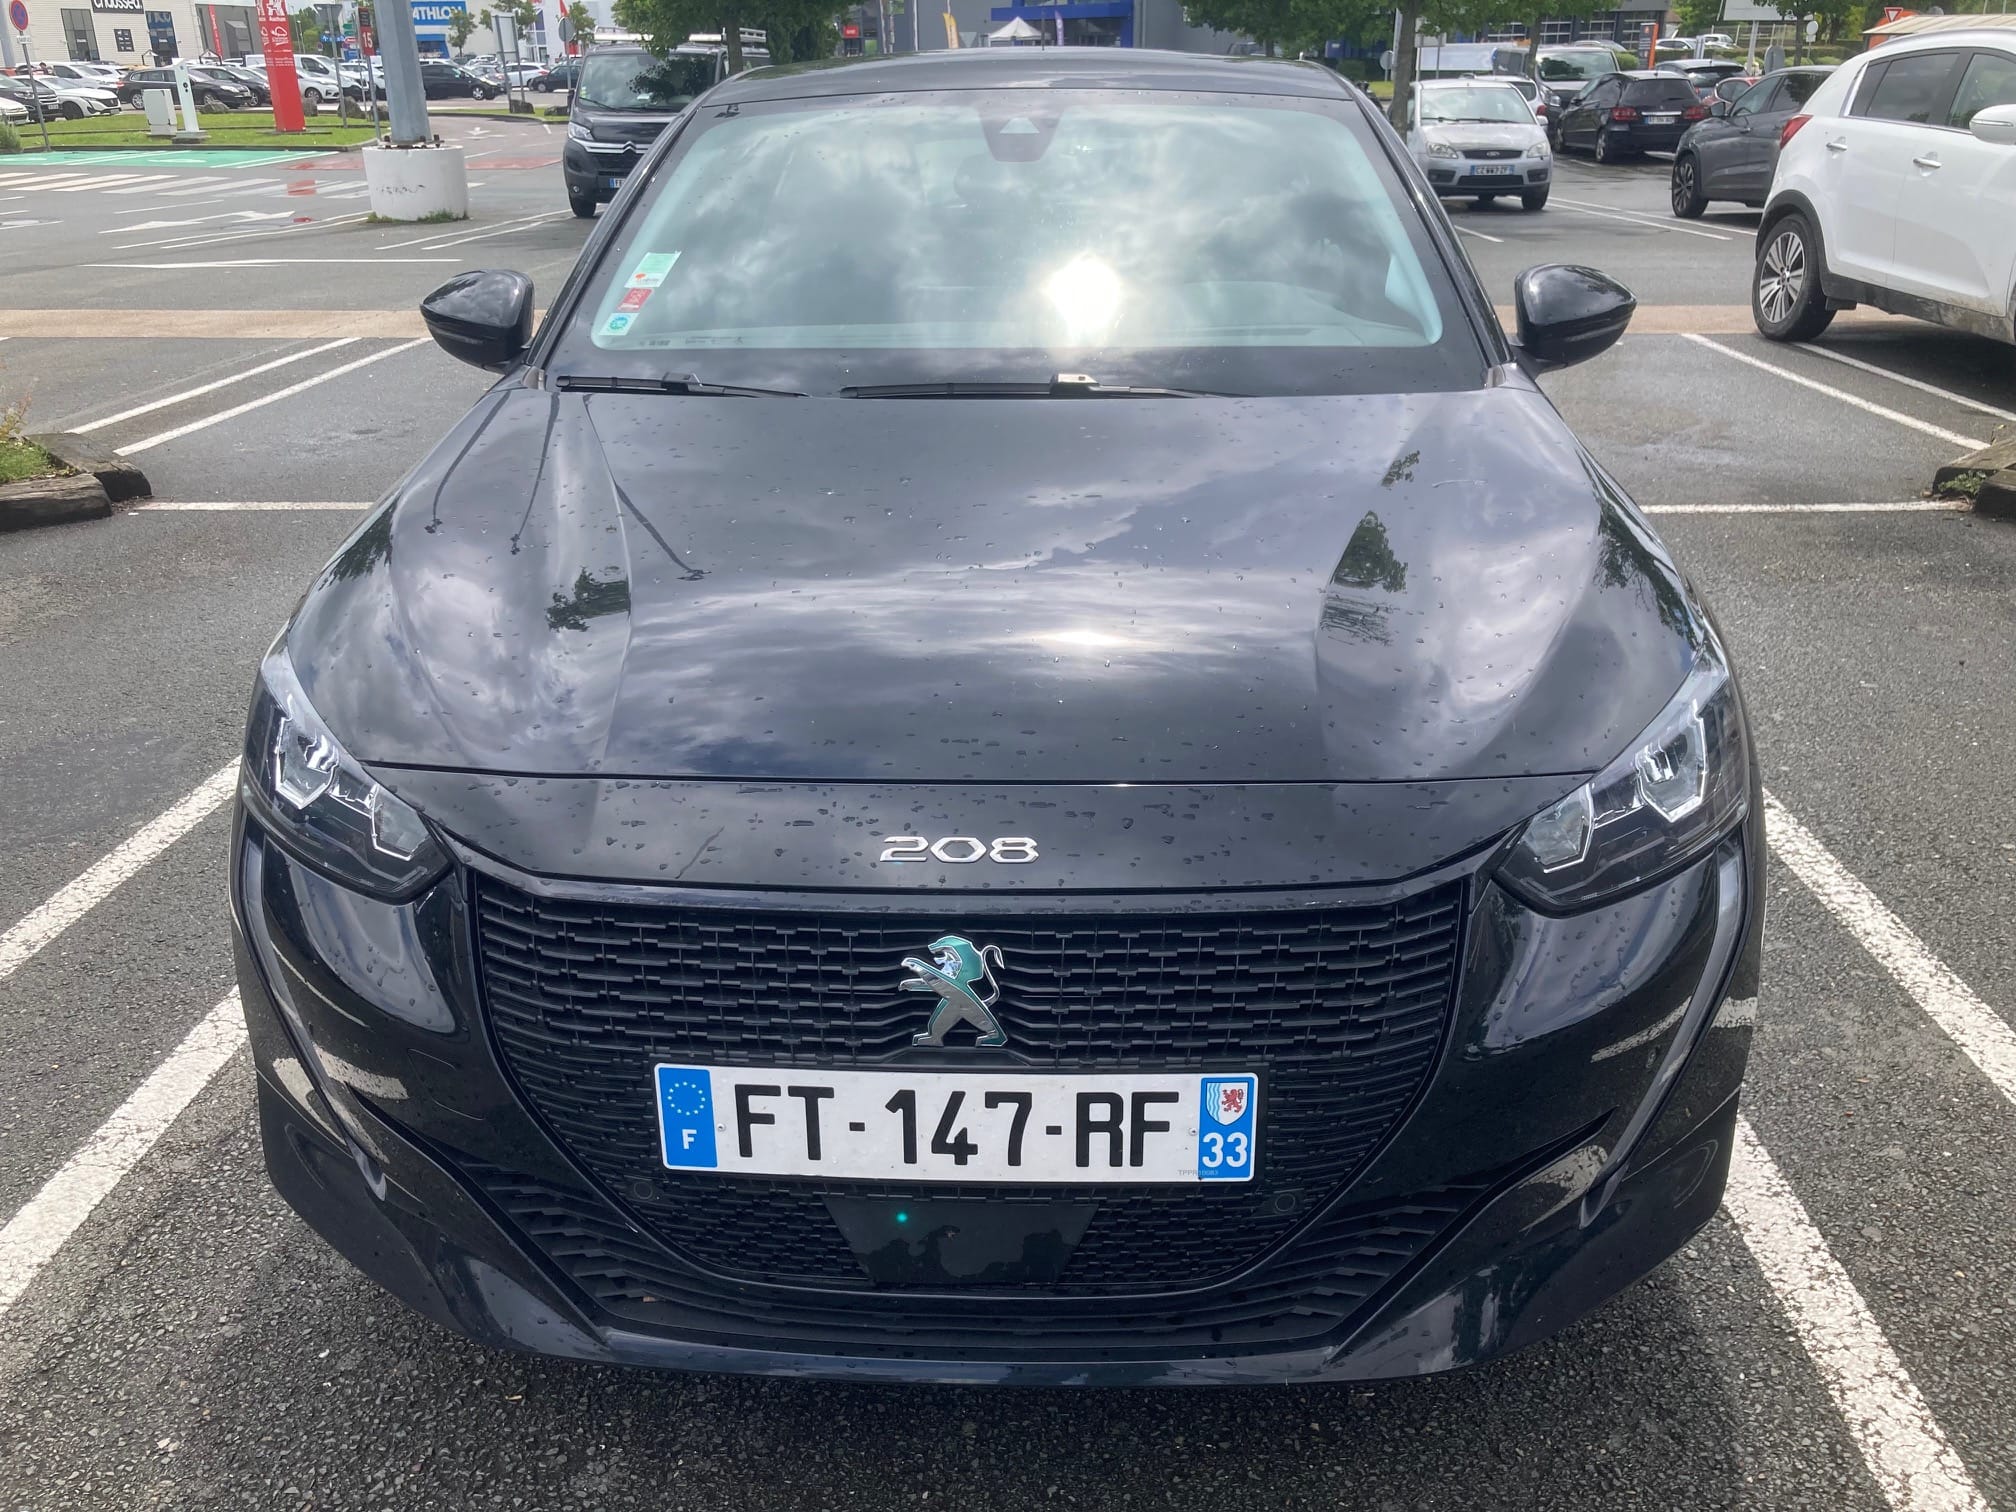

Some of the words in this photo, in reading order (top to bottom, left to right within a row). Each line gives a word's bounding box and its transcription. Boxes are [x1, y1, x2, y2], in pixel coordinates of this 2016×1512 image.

[362, 31, 373, 49] 15
[879, 836, 1040, 863] 208
[682, 1129, 698, 1150] F
[734, 1084, 1180, 1169] FT-147-RF
[1202, 1132, 1248, 1168] 33
